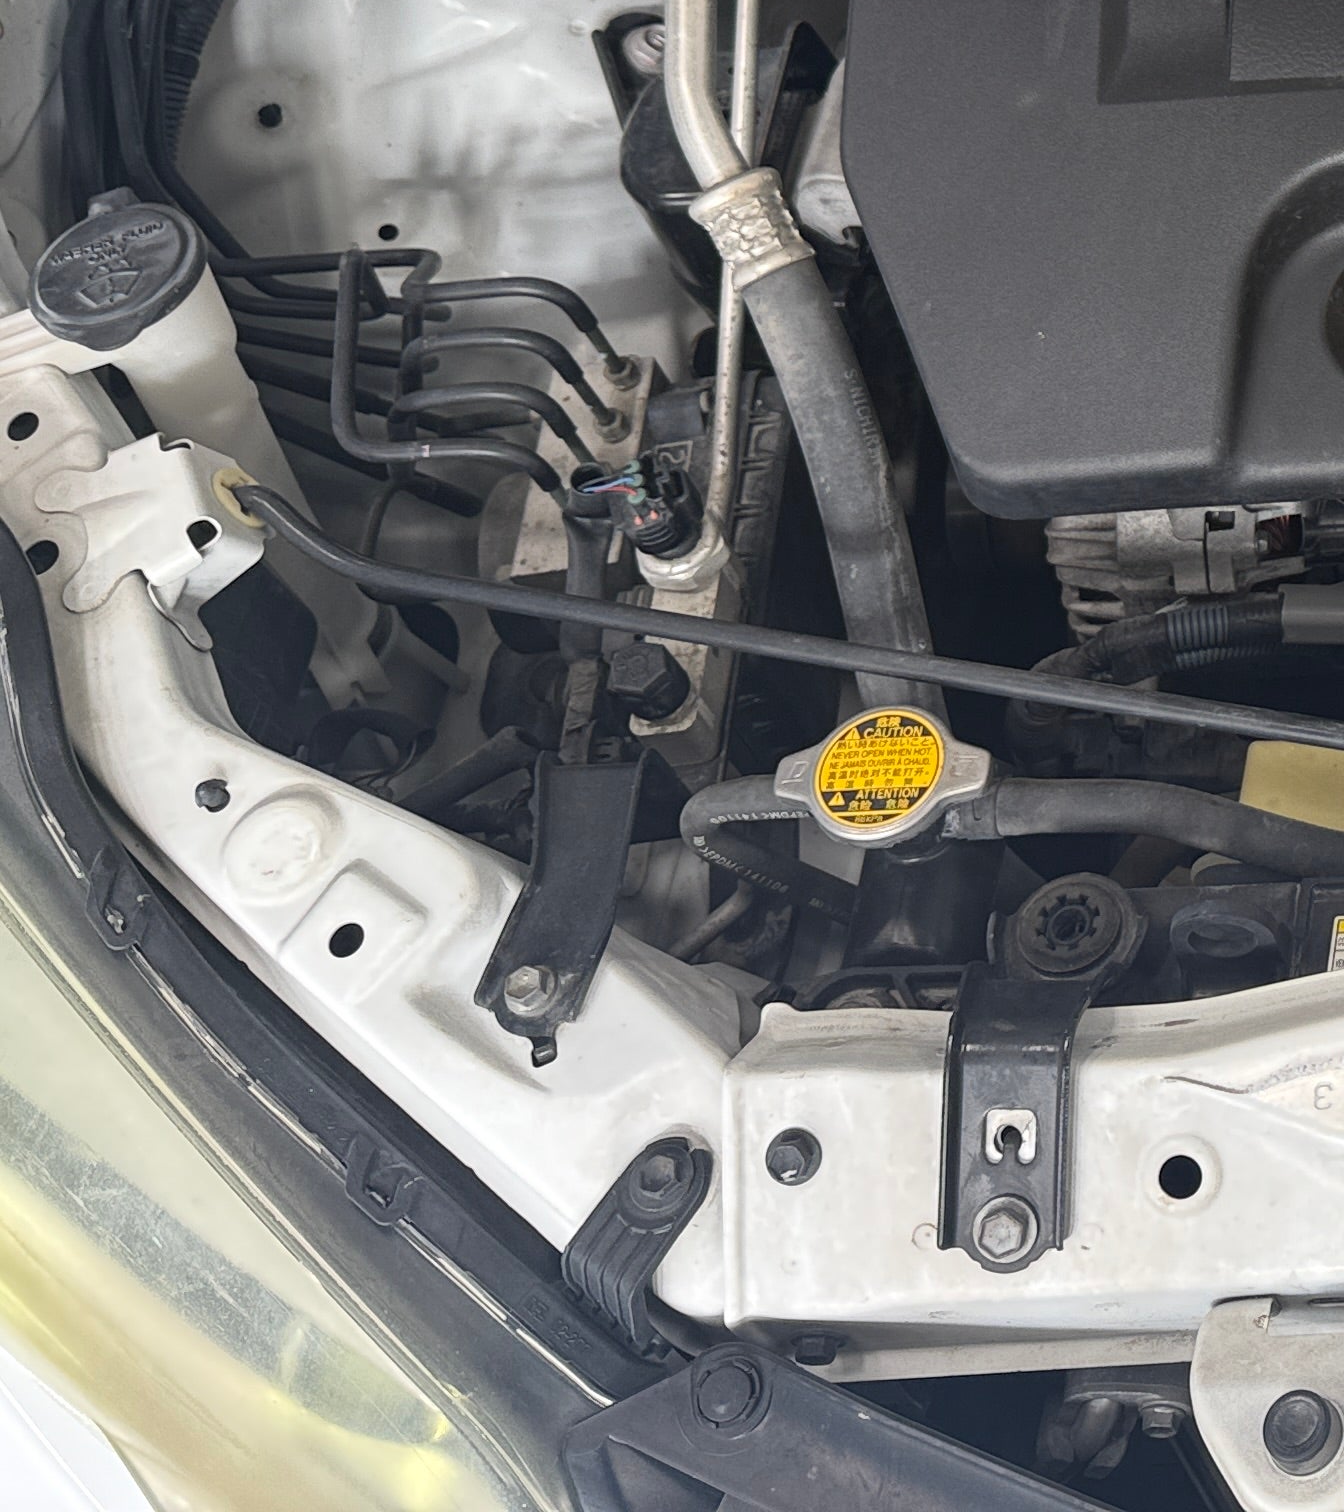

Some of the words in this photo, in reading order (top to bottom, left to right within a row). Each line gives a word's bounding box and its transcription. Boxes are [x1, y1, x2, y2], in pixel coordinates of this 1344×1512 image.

[863, 725, 924, 739] CAUTION
[861, 749, 885, 758] OPEN
[855, 787, 920, 800] ATTENTION
